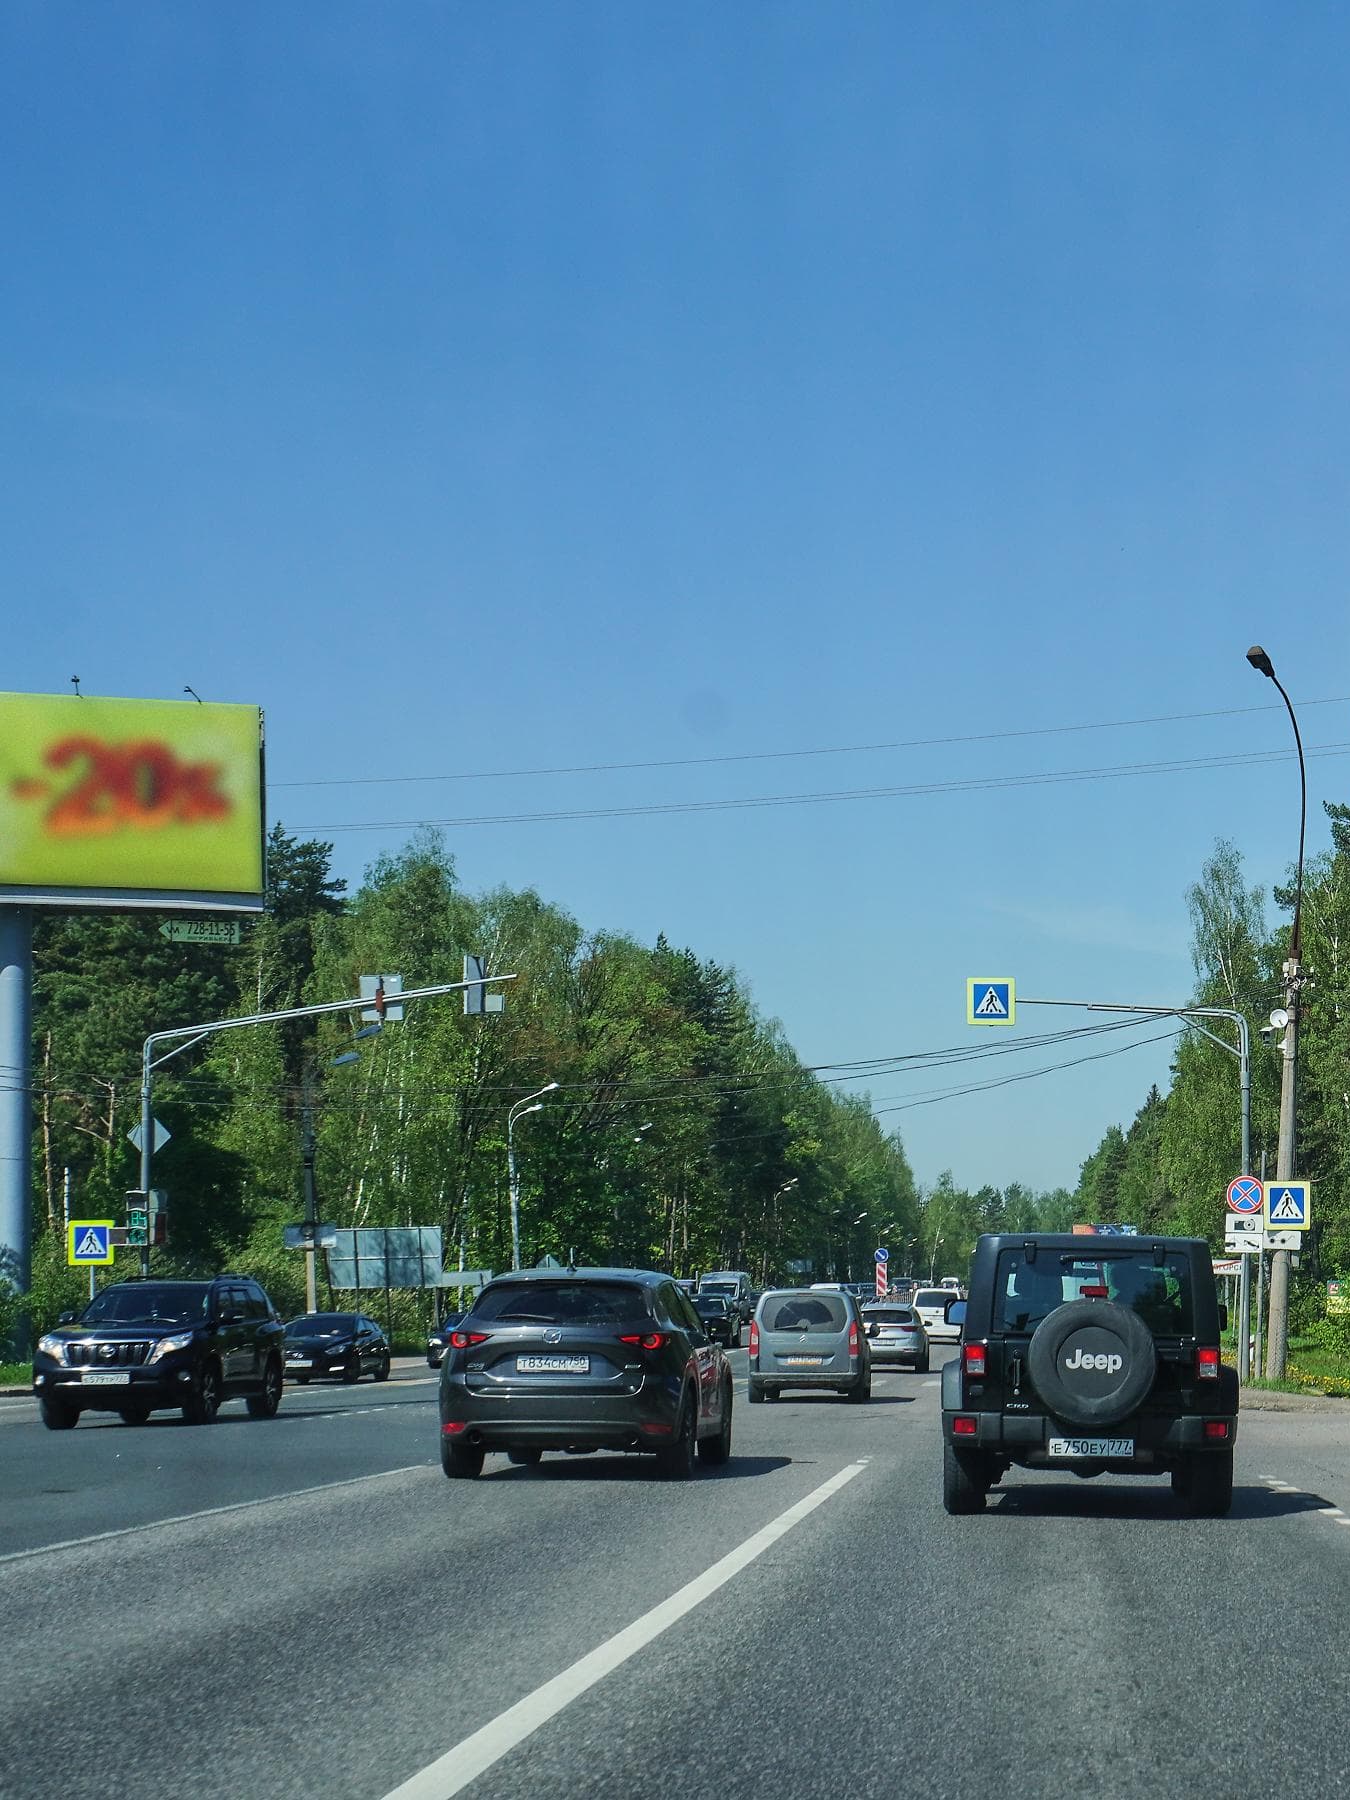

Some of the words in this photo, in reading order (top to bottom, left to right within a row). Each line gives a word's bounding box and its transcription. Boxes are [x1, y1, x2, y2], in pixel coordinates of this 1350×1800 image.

[1065, 1349, 1122, 1374] Jeep
[1054, 1440, 1105, 1455] Е750ЕУ
[1109, 1440, 1131, 1452] 777
